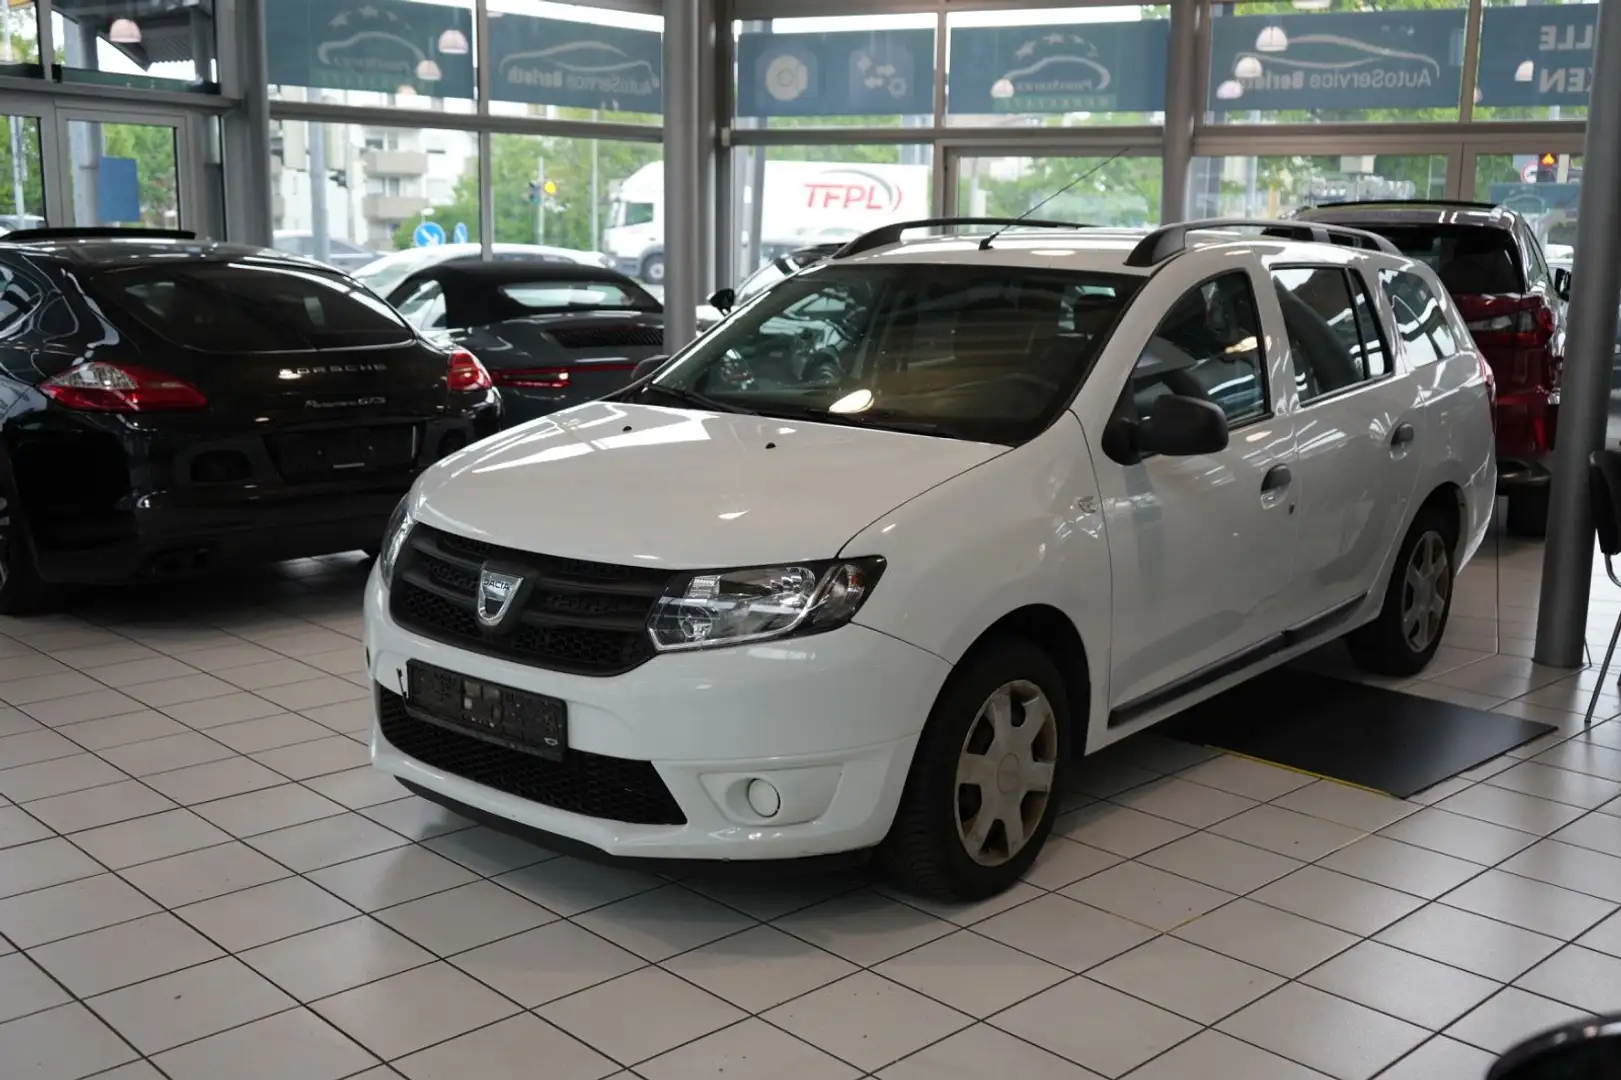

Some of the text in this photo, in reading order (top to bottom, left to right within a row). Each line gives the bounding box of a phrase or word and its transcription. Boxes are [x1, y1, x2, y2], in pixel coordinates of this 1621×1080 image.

[804, 183, 882, 209] TFPL
[279, 364, 387, 378] PORSCHE
[483, 578, 510, 591] DACIA
